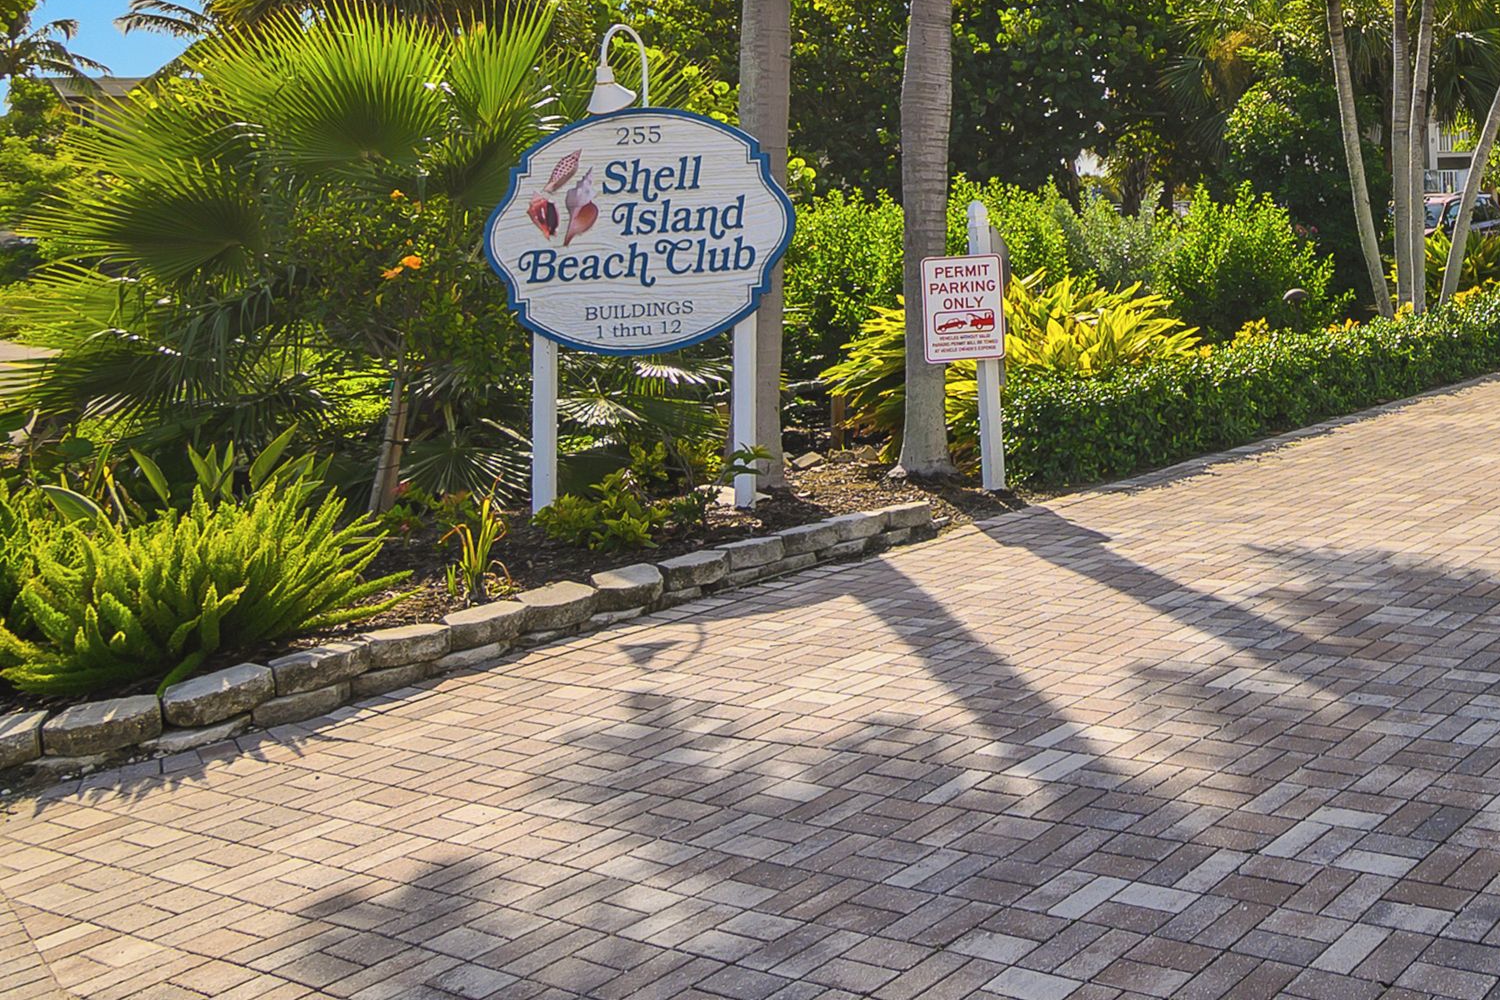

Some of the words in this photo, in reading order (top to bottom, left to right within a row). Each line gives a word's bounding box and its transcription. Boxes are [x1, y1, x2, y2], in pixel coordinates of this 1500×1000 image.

[616, 125, 662, 145] 255
[602, 155, 702, 202] Shell
[612, 194, 745, 239] Island
[518, 242, 656, 287] Beach
[654, 236, 756, 274] Club
[934, 264, 990, 279] PERMIT
[930, 280, 996, 295] PARKING
[585, 300, 694, 321] BUILDINGS
[943, 296, 984, 310] ONLY
[596, 325, 604, 339] 1
[612, 323, 652, 338] thru
[661, 319, 682, 335] 12
